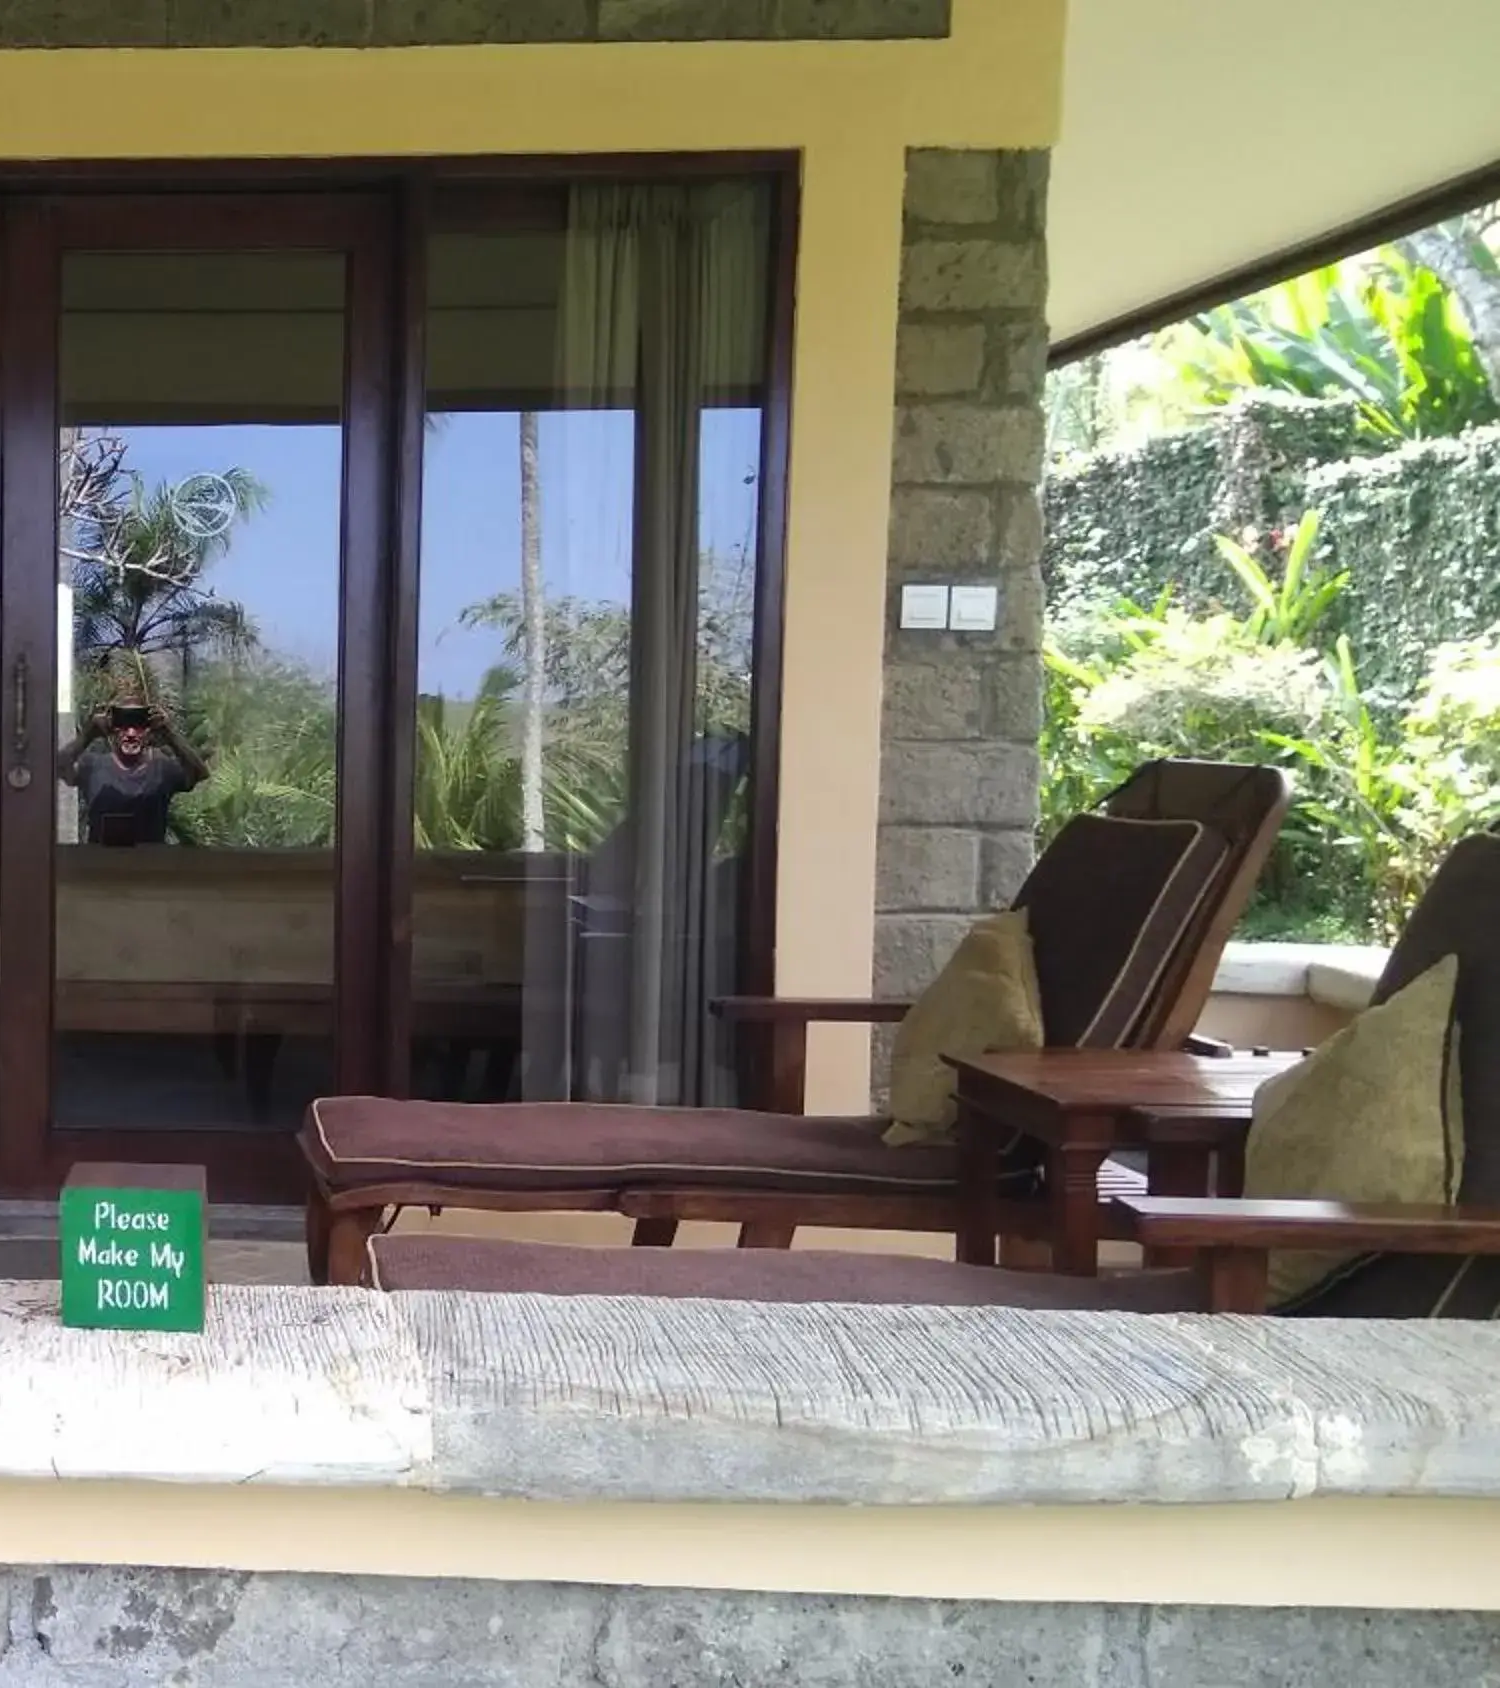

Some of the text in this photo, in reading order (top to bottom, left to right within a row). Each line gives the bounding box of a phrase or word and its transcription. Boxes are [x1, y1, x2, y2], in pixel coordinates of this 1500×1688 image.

[94, 1201, 170, 1231] Please
[78, 1236, 184, 1278] Make My
[97, 1279, 169, 1310] ROOM
